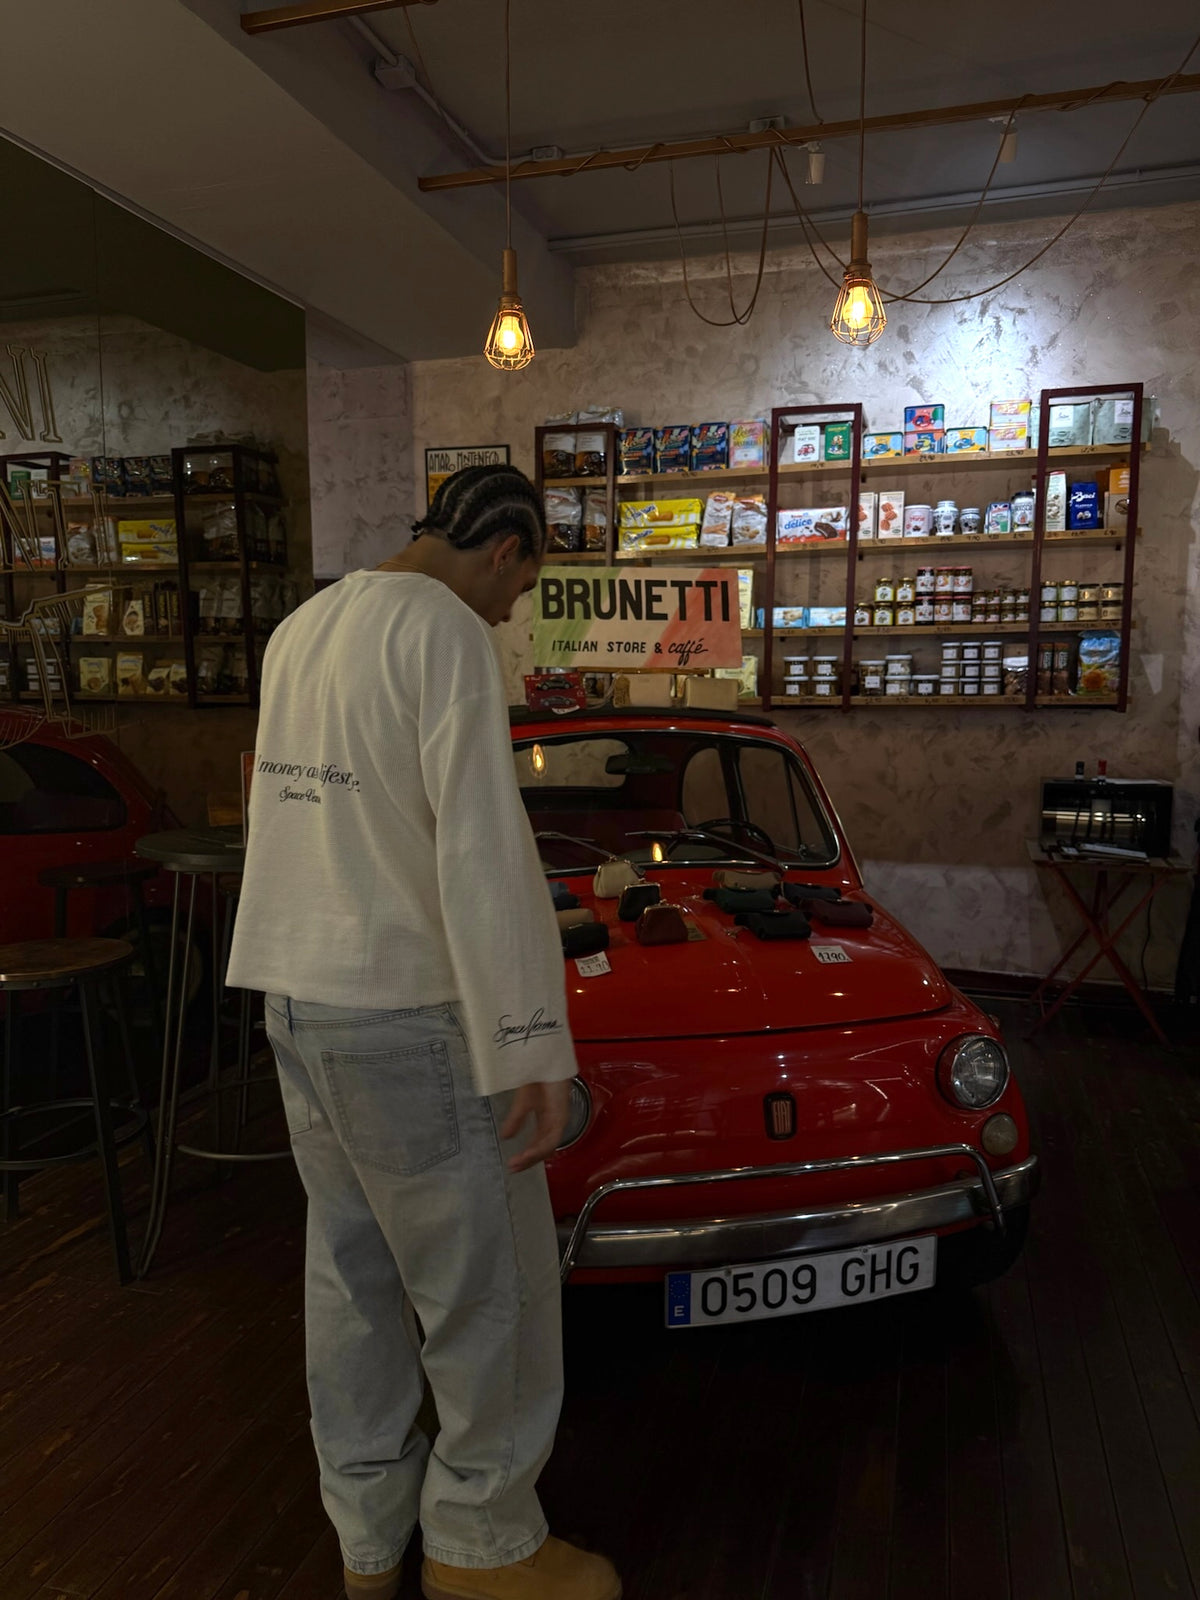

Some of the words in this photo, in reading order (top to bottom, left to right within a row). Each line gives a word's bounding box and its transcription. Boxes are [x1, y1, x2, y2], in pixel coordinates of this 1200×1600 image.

[541, 578, 730, 622] BRUNETTI
[552, 640, 598, 653] ITALIAN
[607, 641, 646, 654] STORE
[654, 643, 663, 654] &
[258, 759, 304, 782] money
[701, 1264, 817, 1317] 0509
[841, 1246, 919, 1297] GHG
[674, 1305, 685, 1317] E
